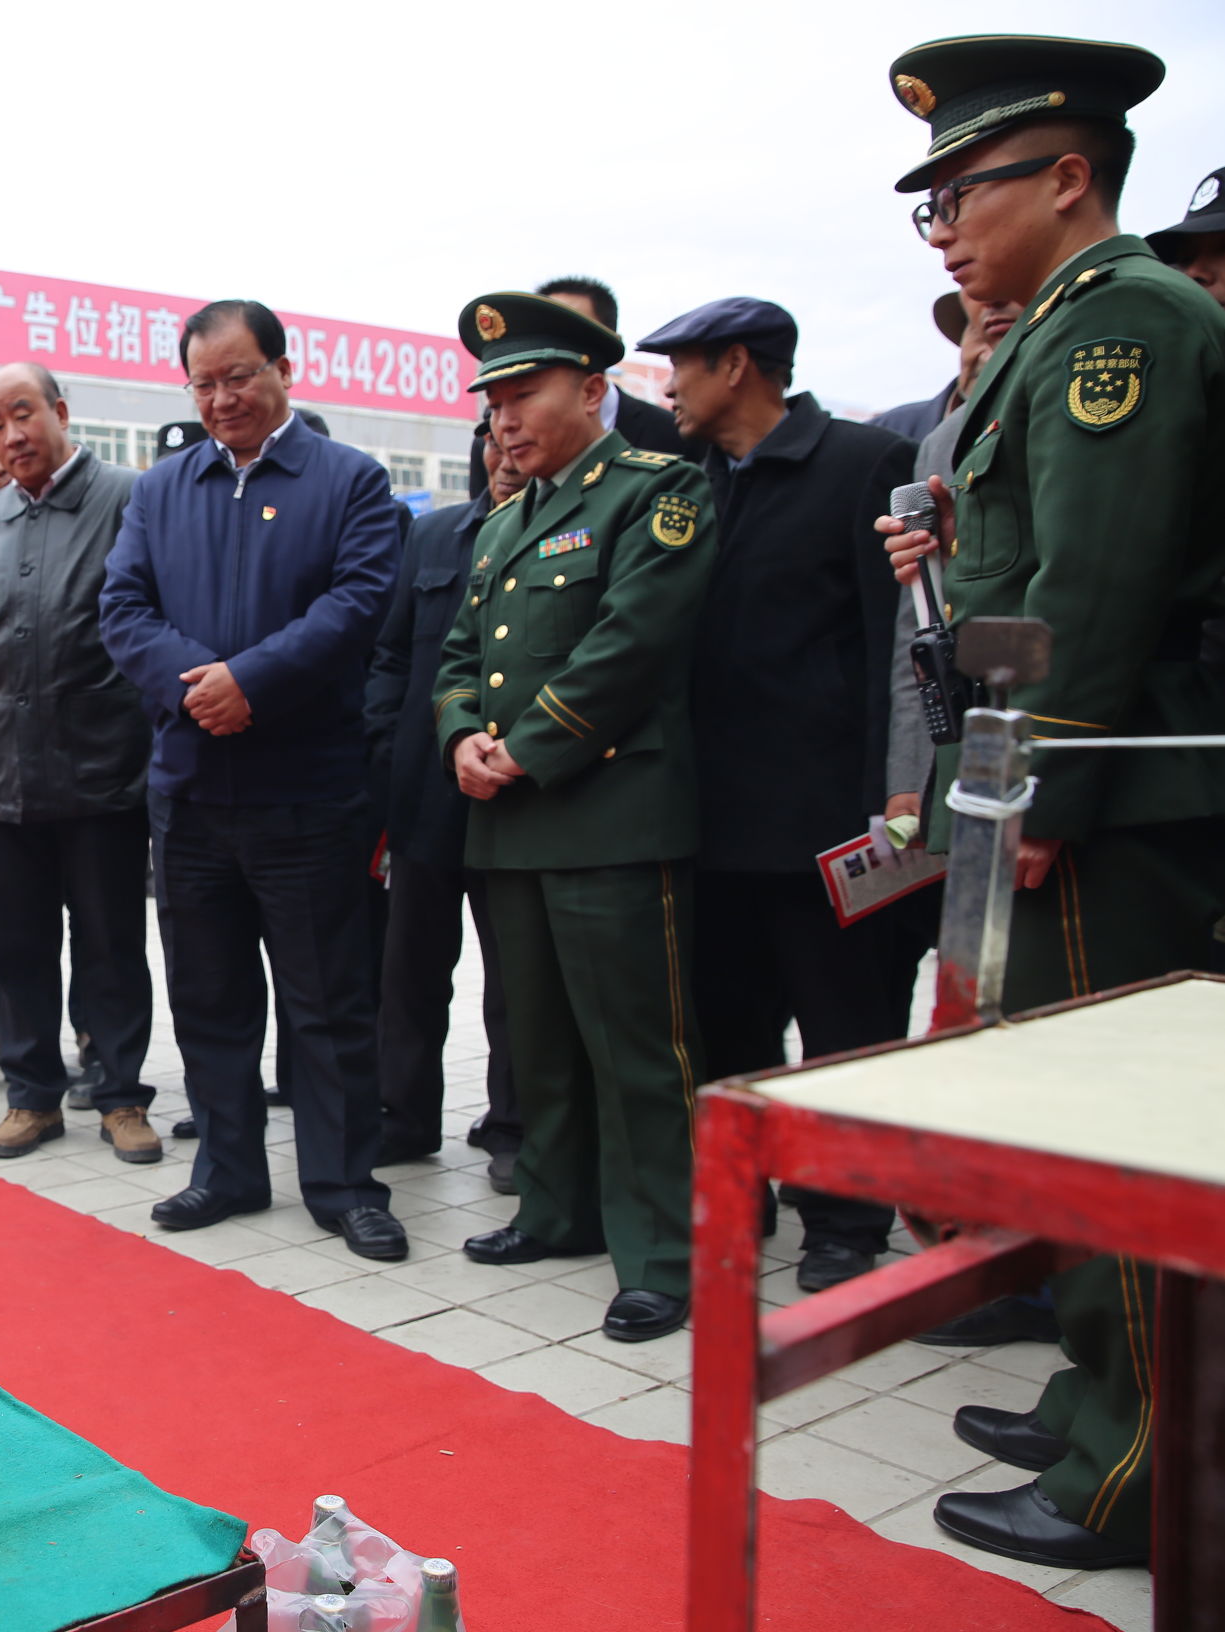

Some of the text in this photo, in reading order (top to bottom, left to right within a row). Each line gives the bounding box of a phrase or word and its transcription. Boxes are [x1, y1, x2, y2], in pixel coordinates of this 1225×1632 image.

[286, 325, 460, 403] 95442888
[1074, 345, 1142, 359] 中国人民
